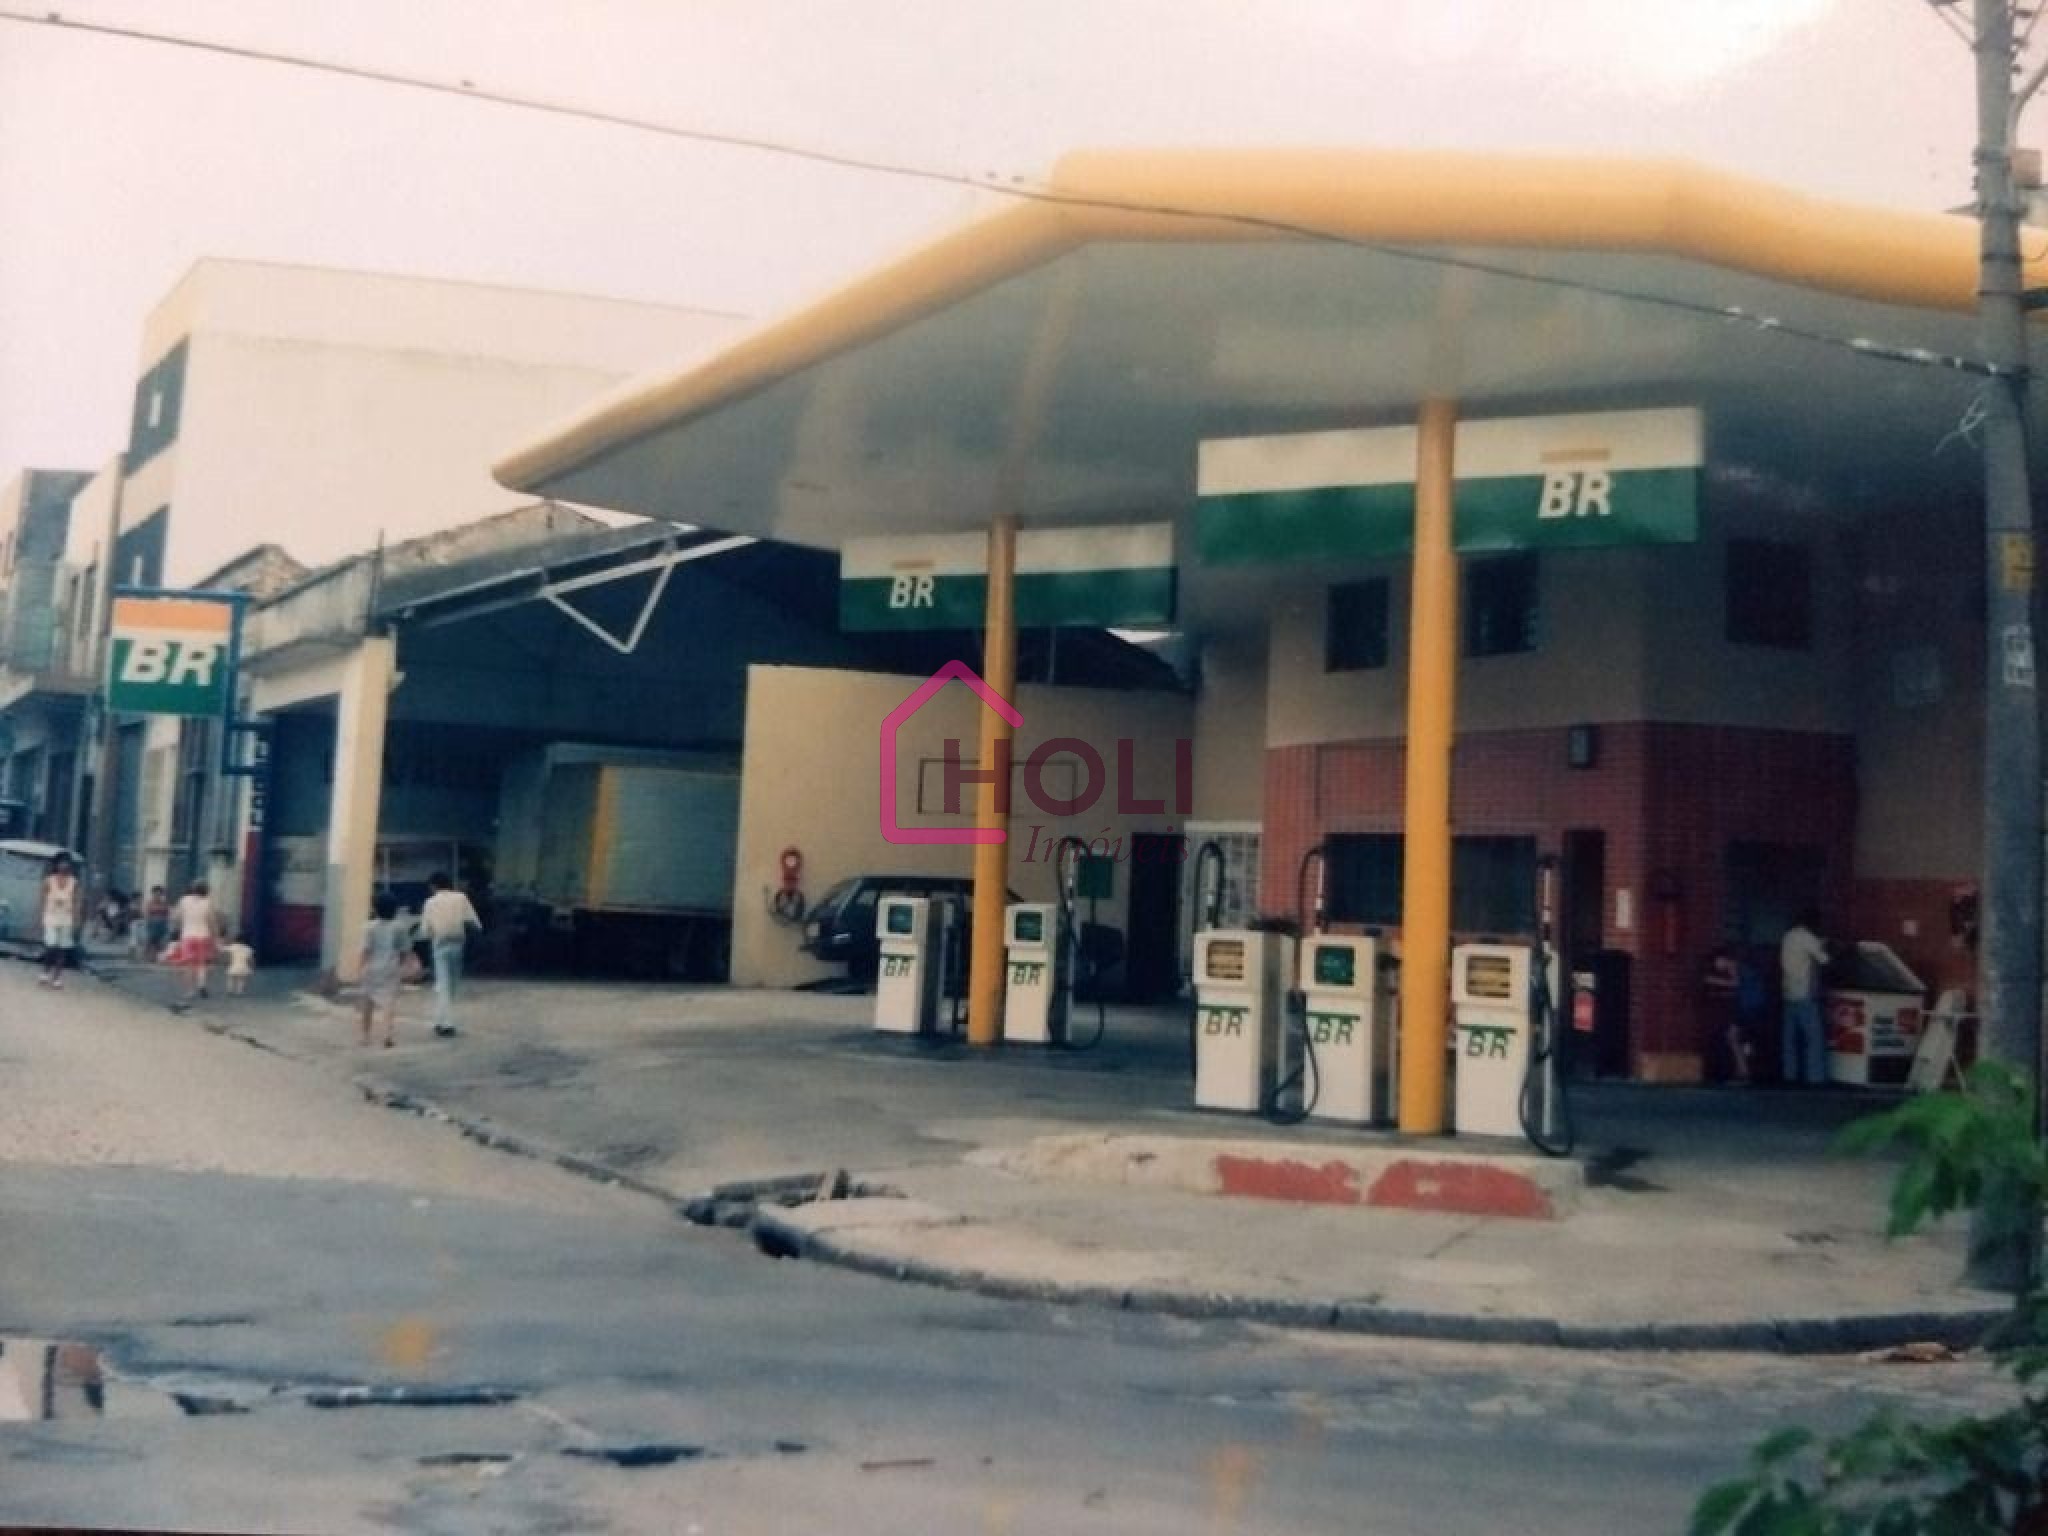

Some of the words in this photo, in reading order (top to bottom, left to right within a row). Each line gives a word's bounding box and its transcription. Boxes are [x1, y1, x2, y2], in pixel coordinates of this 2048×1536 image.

[1538, 470, 1612, 517] BR
[889, 574, 934, 609] BR
[121, 638, 220, 686] BR
[884, 956, 912, 977] BR
[1013, 963, 1041, 985] BR
[1204, 1009, 1243, 1037] BR
[1313, 1015, 1354, 1045] BR
[1466, 1026, 1508, 1058] BR
